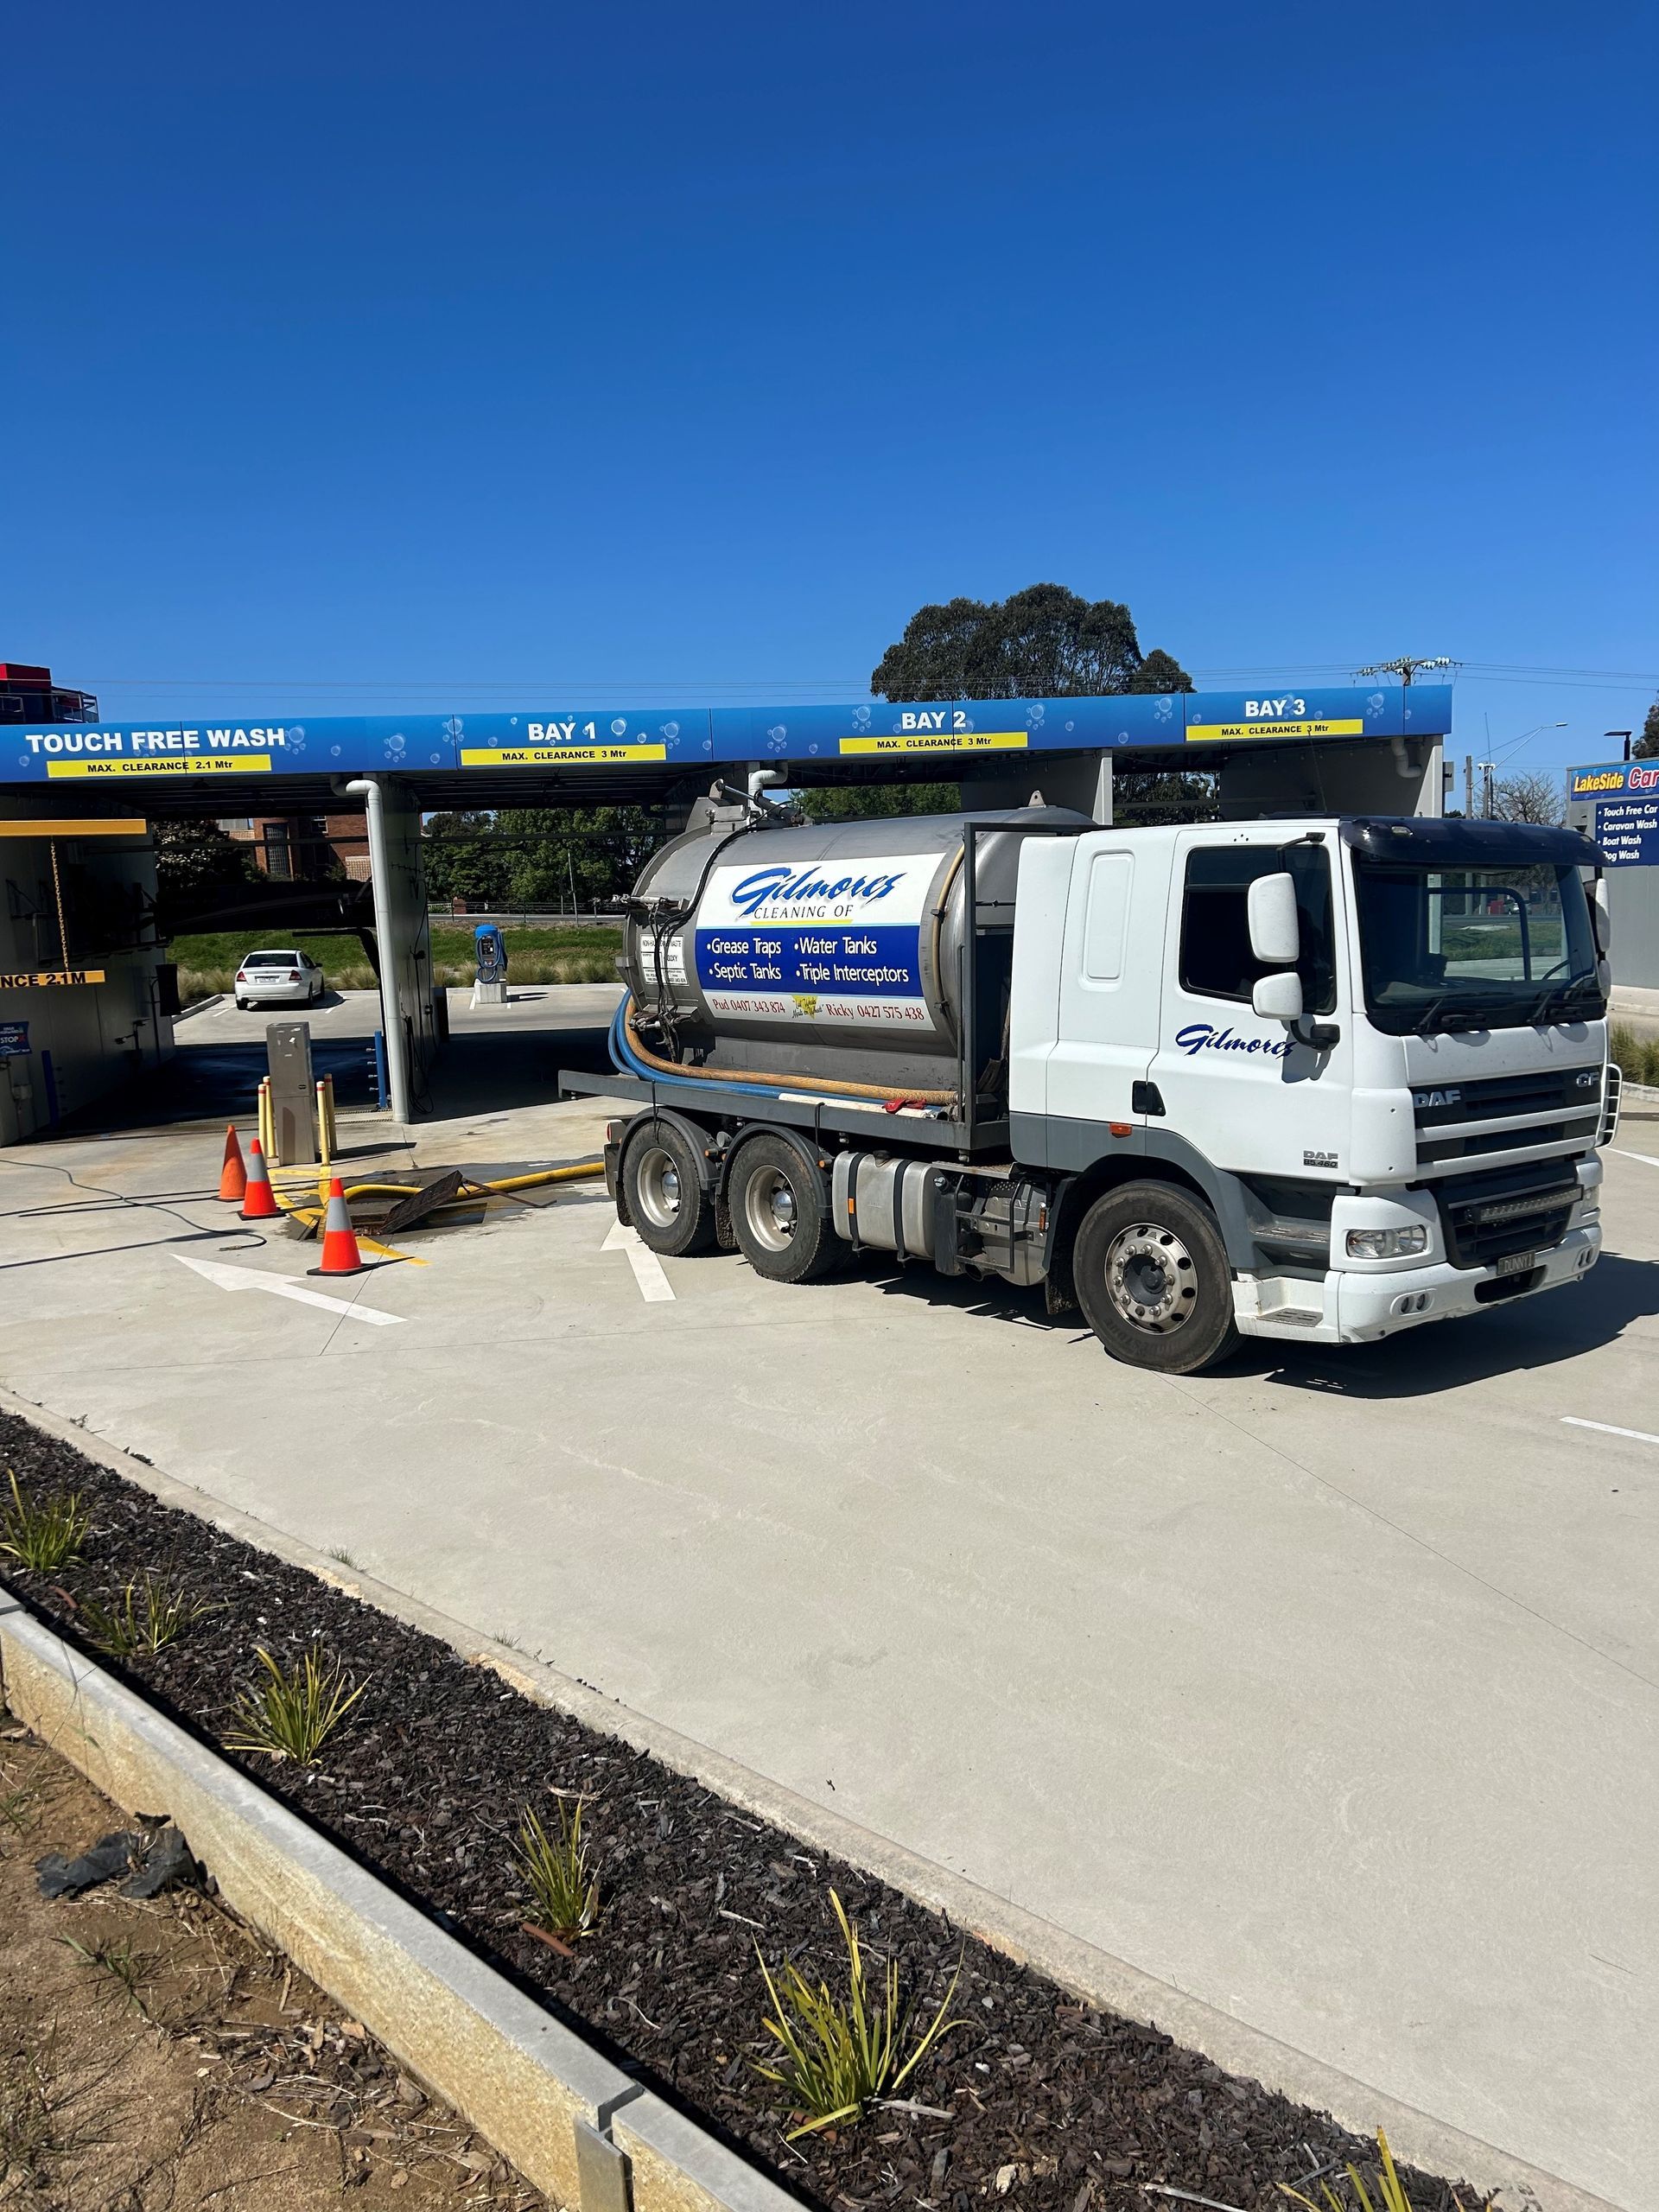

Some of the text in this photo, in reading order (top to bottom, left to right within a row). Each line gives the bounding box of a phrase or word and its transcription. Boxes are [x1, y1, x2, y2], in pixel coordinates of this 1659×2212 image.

[1245, 698, 1306, 717] BAY 3
[902, 710, 966, 729] BAY 2
[528, 722, 595, 741] BAY 1
[1249, 726, 1301, 734] CLEARANCE
[26, 728, 285, 753] TOUCH FREE WASH
[906, 739, 963, 747] CLEARANCE
[502, 752, 528, 760] MAX.
[534, 751, 595, 760] CLEARANCE
[87, 760, 233, 773] MAX. CLEARANCE 2.1 Mtr
[1573, 772, 1624, 792] LakeSide
[1604, 804, 1658, 817] Touch Free Car
[1604, 819, 1657, 830] Caravan Wash
[1603, 835, 1642, 846] Boat Wash
[1618, 849, 1640, 860] Wash
[732, 866, 907, 918] Gilmores
[753, 905, 854, 919] CLEANING OF
[711, 938, 781, 958] Grease Traps
[799, 936, 877, 955] Water Tanks
[714, 963, 782, 982] Septic Tanks
[799, 963, 909, 987] Triple Interceptors
[712, 999, 729, 1010] Pud
[730, 1000, 751, 1011] 0407
[752, 1001, 769, 1012] 343
[770, 1001, 785, 1013] 874
[825, 1003, 855, 1020] Ricky
[856, 1005, 881, 1018] 0427
[882, 1006, 903, 1019] 575
[905, 1007, 925, 1020] 438
[1175, 1024, 1298, 1059] Gilmores
[1414, 1090, 1461, 1108] DAF
[1304, 1150, 1338, 1160] DAF
